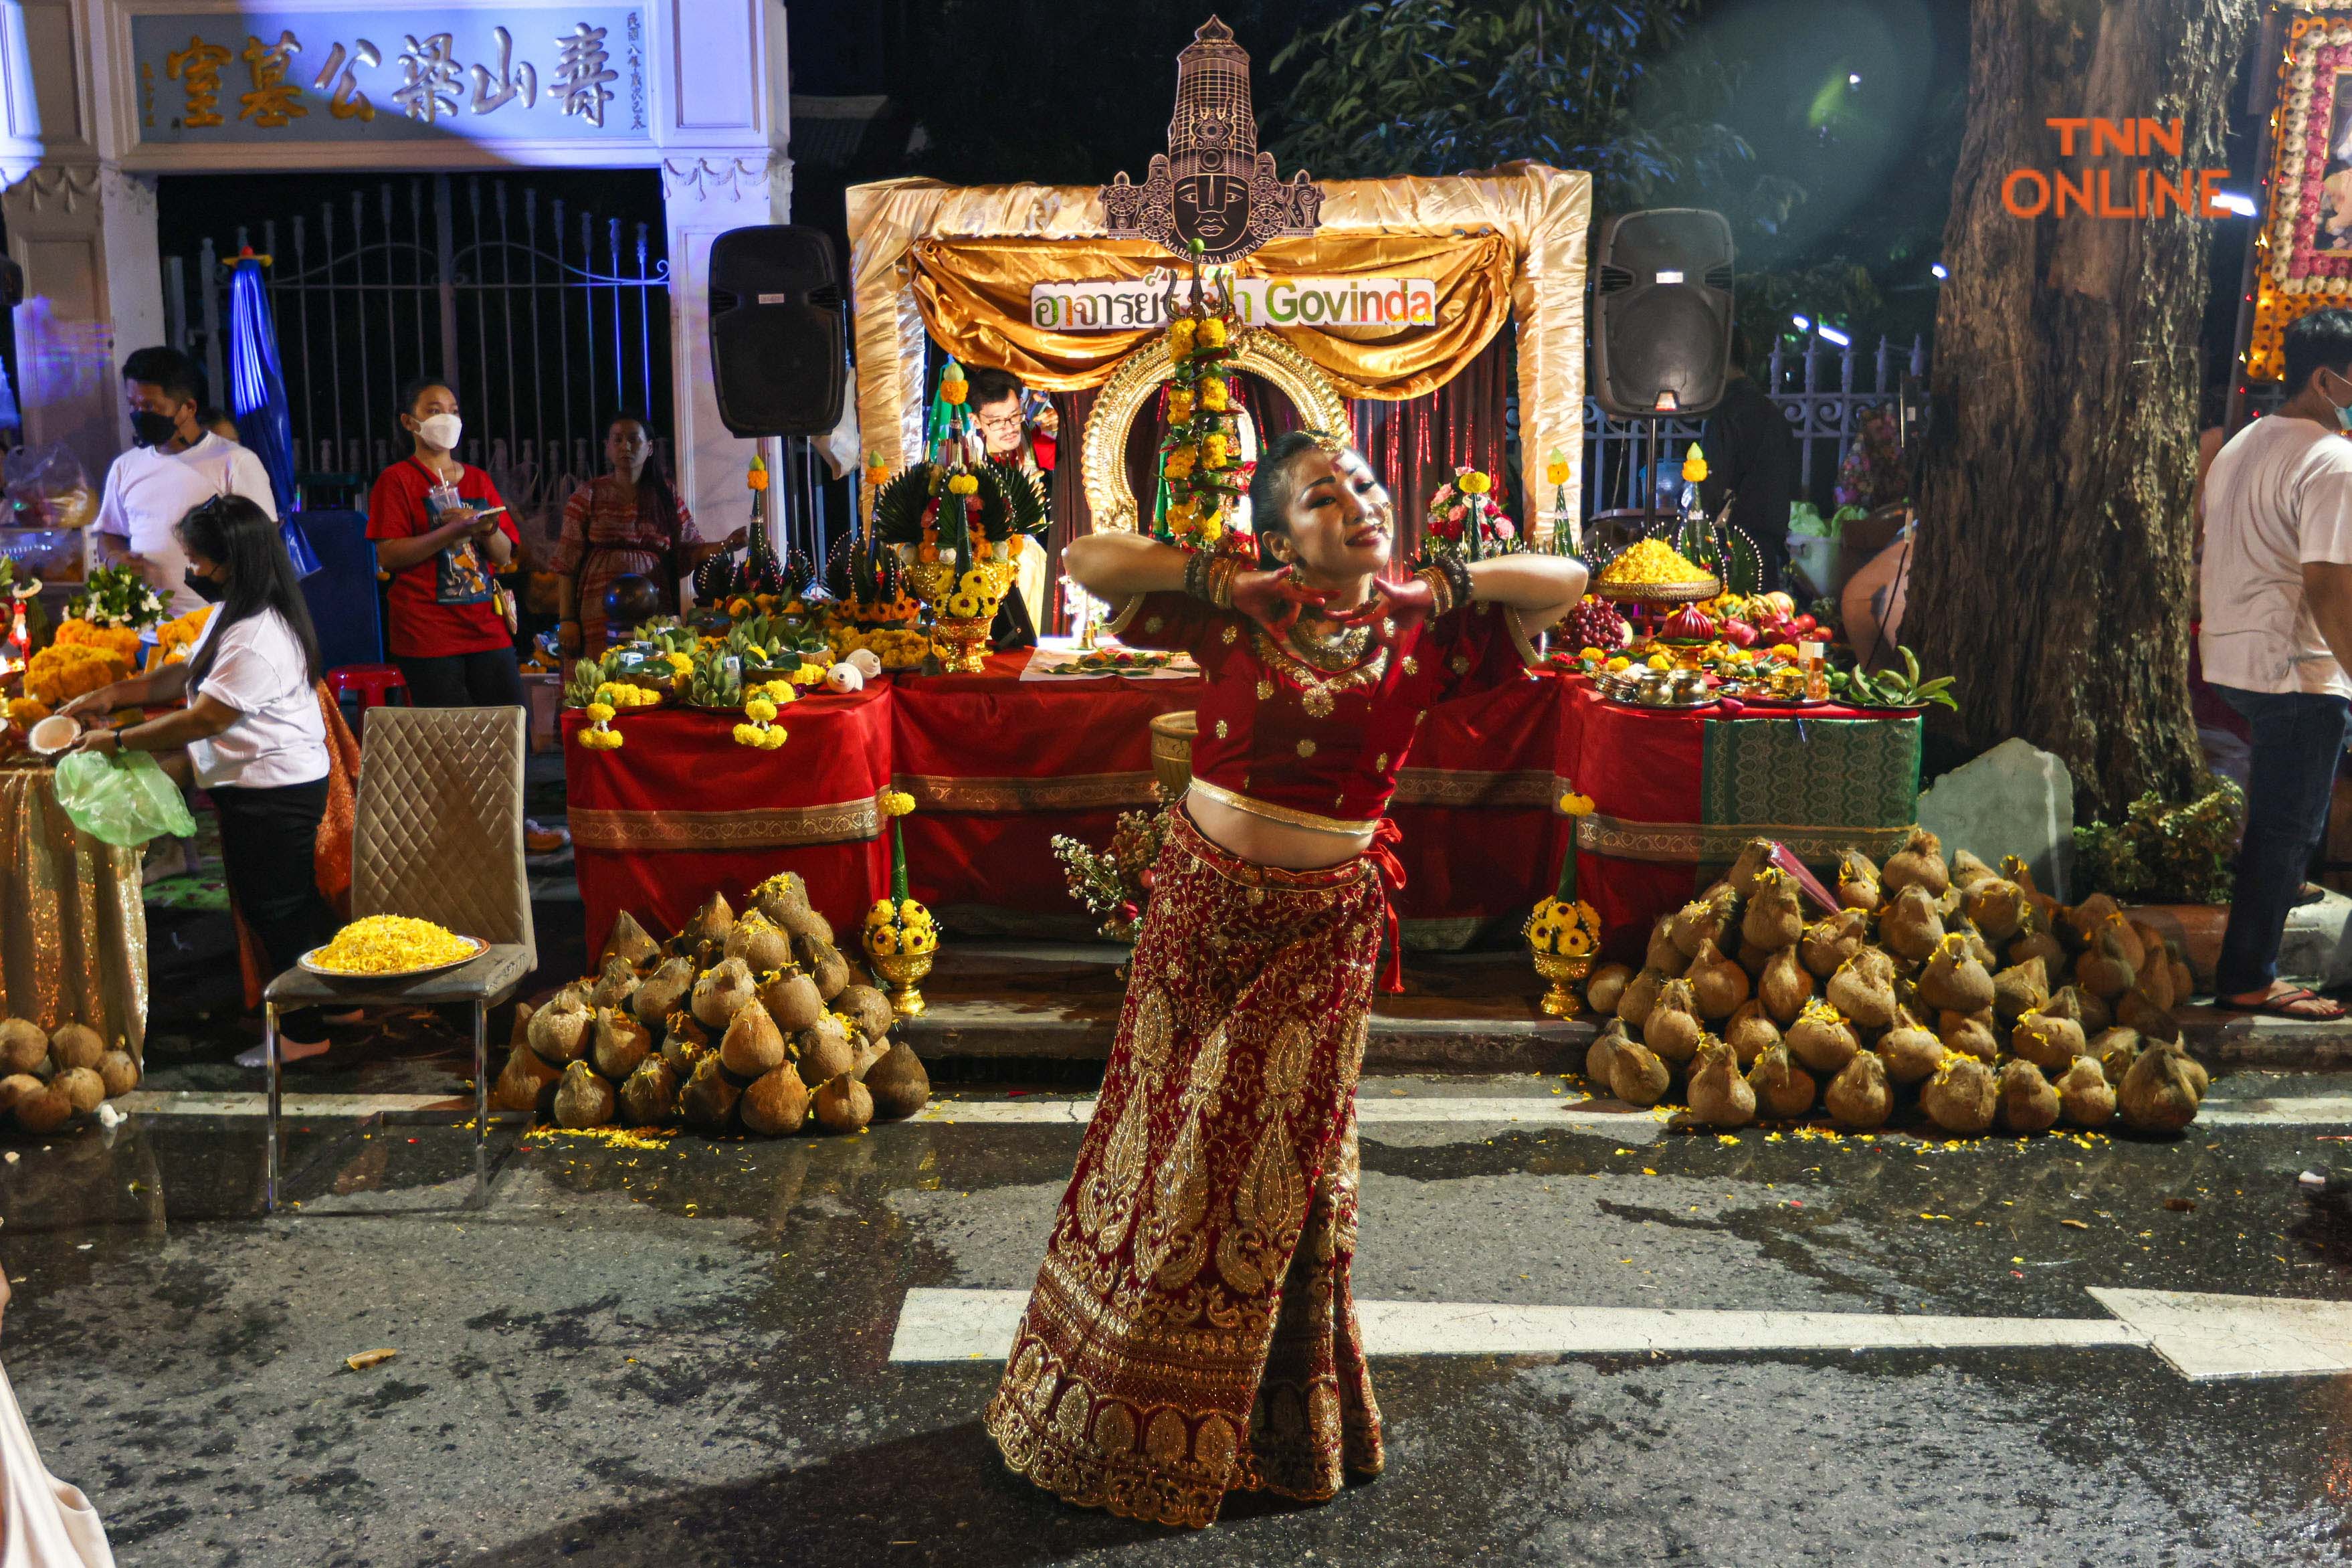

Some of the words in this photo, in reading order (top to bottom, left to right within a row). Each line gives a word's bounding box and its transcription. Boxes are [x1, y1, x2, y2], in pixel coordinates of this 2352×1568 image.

[166, 21, 619, 128] 壽山梁公墓室
[1163, 239, 1222, 264] MAHAEVA
[1226, 239, 1264, 263] DIDEVA
[1264, 280, 1434, 322] Govinda
